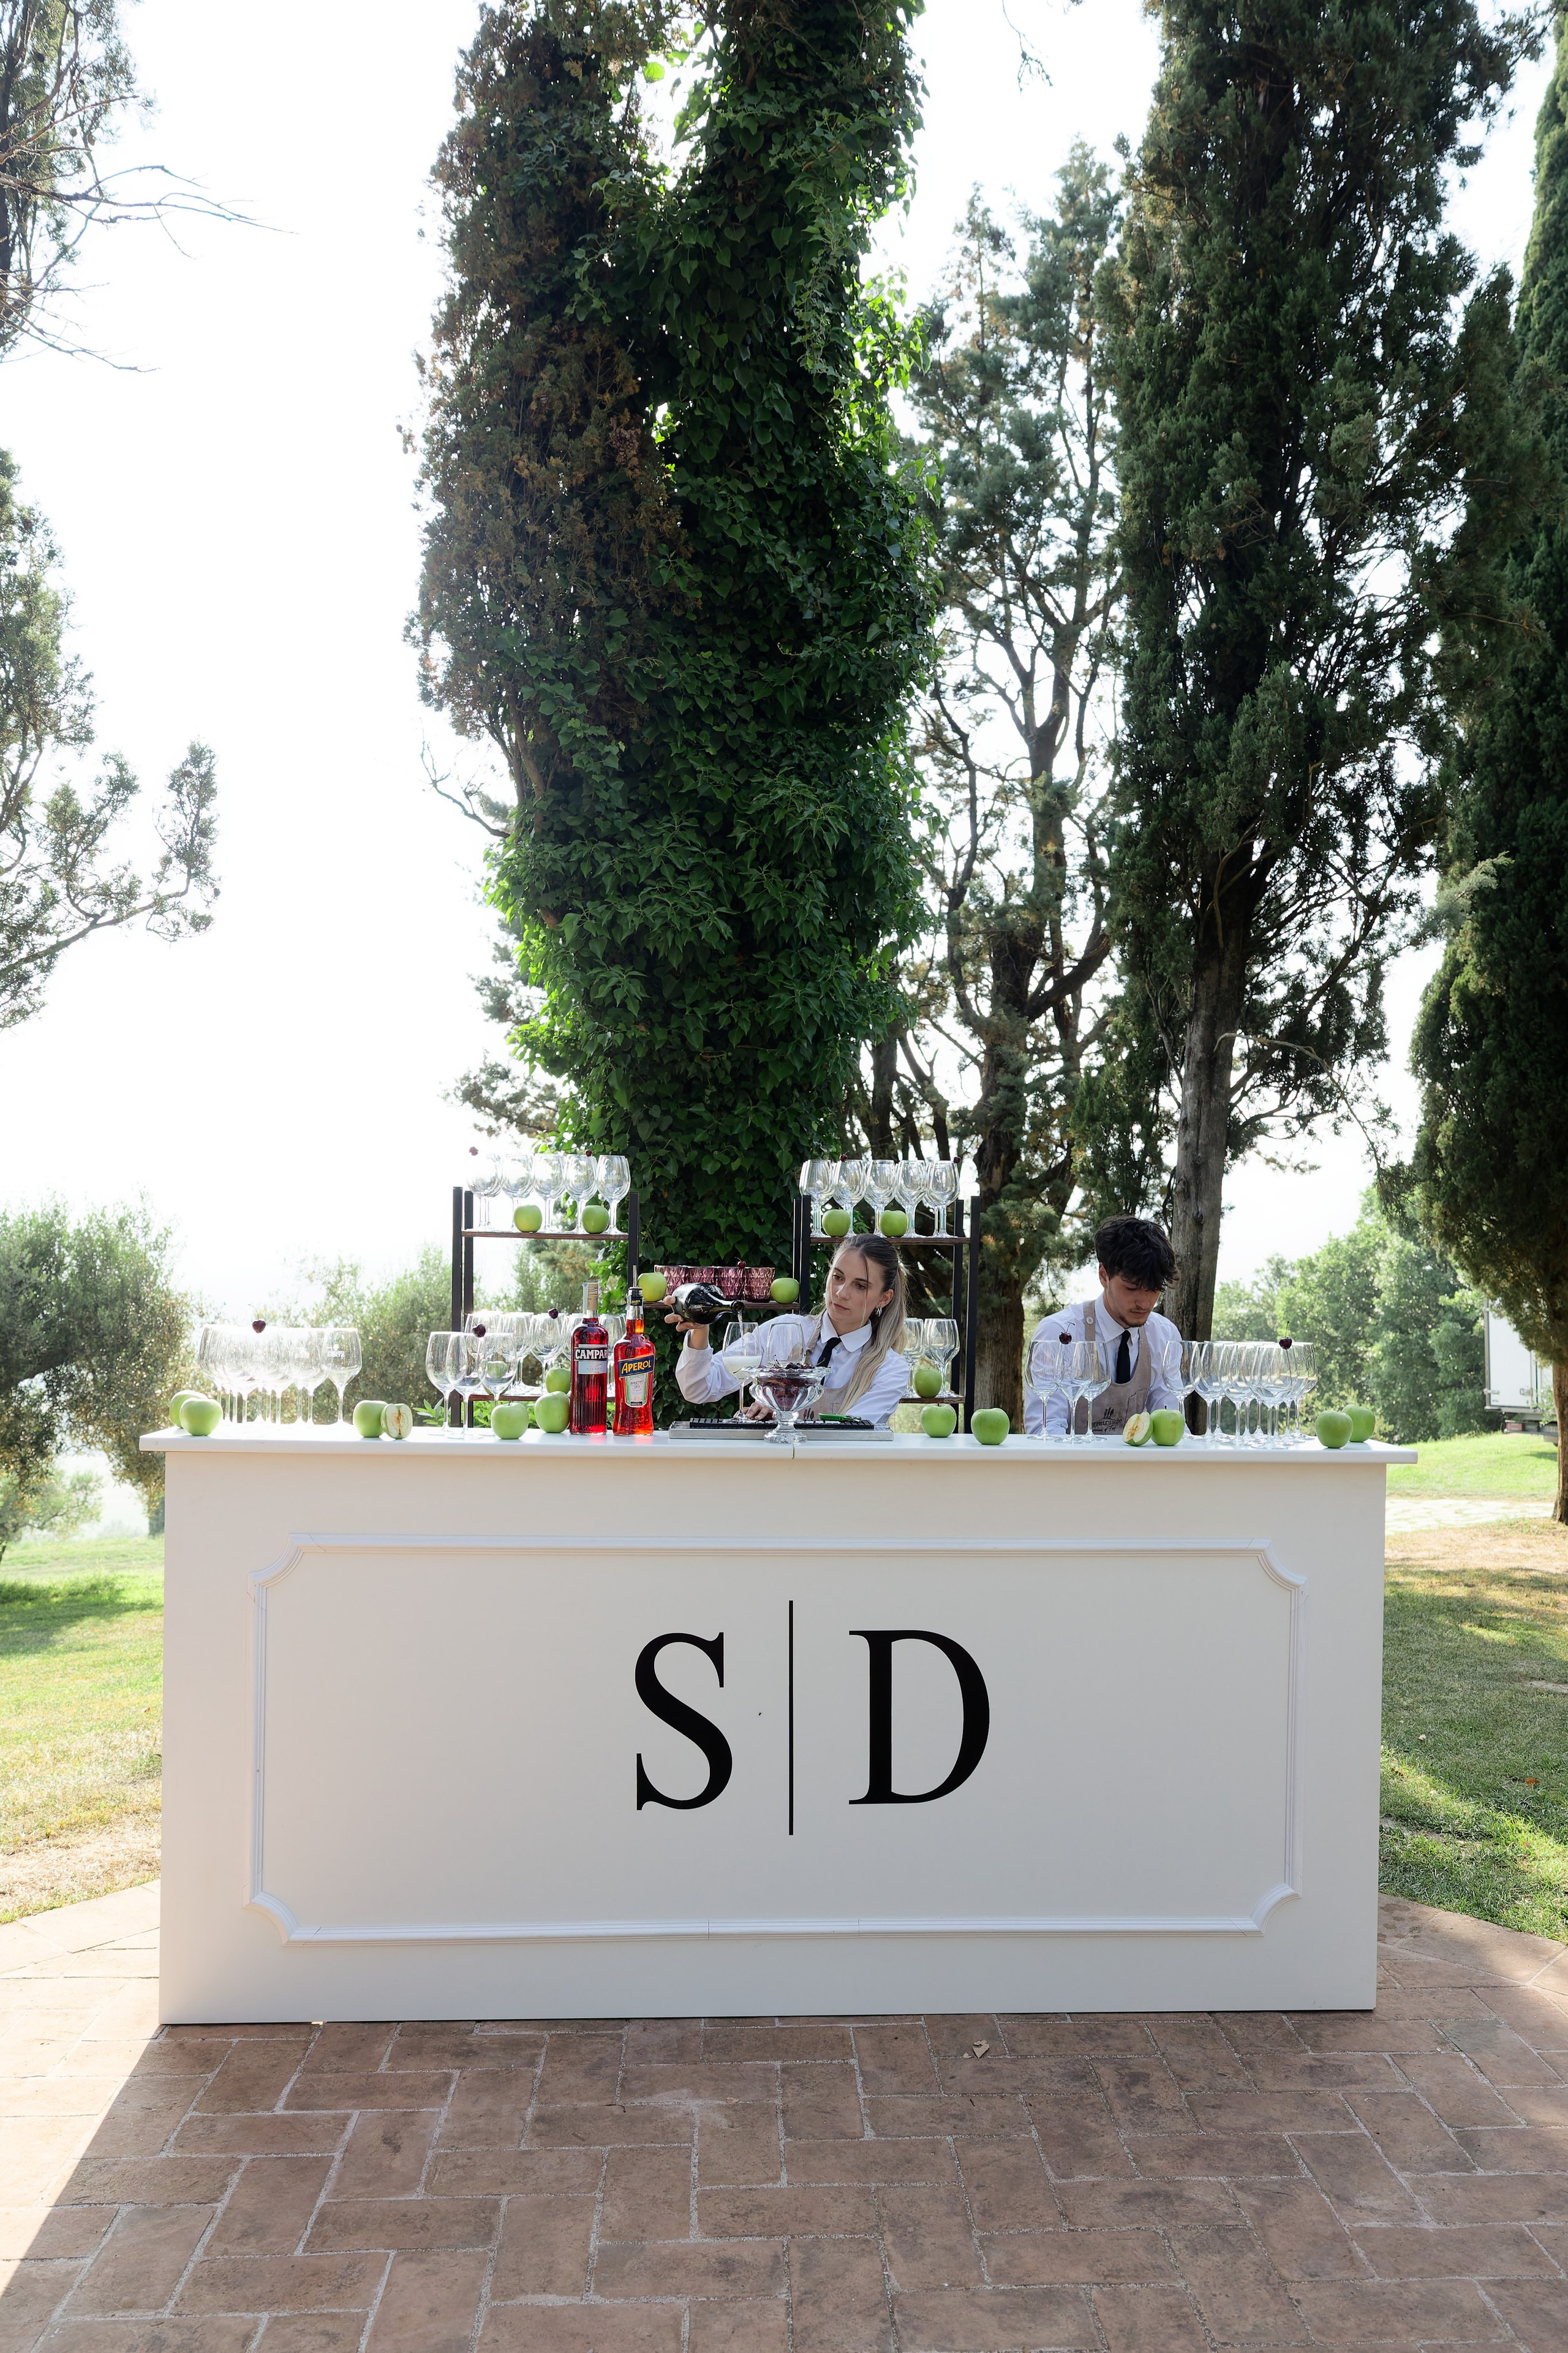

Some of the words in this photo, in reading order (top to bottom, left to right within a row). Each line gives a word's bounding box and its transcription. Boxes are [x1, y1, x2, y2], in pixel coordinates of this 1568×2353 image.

[575, 1349, 608, 1359] CAMPAR
[622, 1360, 652, 1374] APEROL
[635, 1633, 733, 1811] S
[849, 1630, 990, 1805] D
